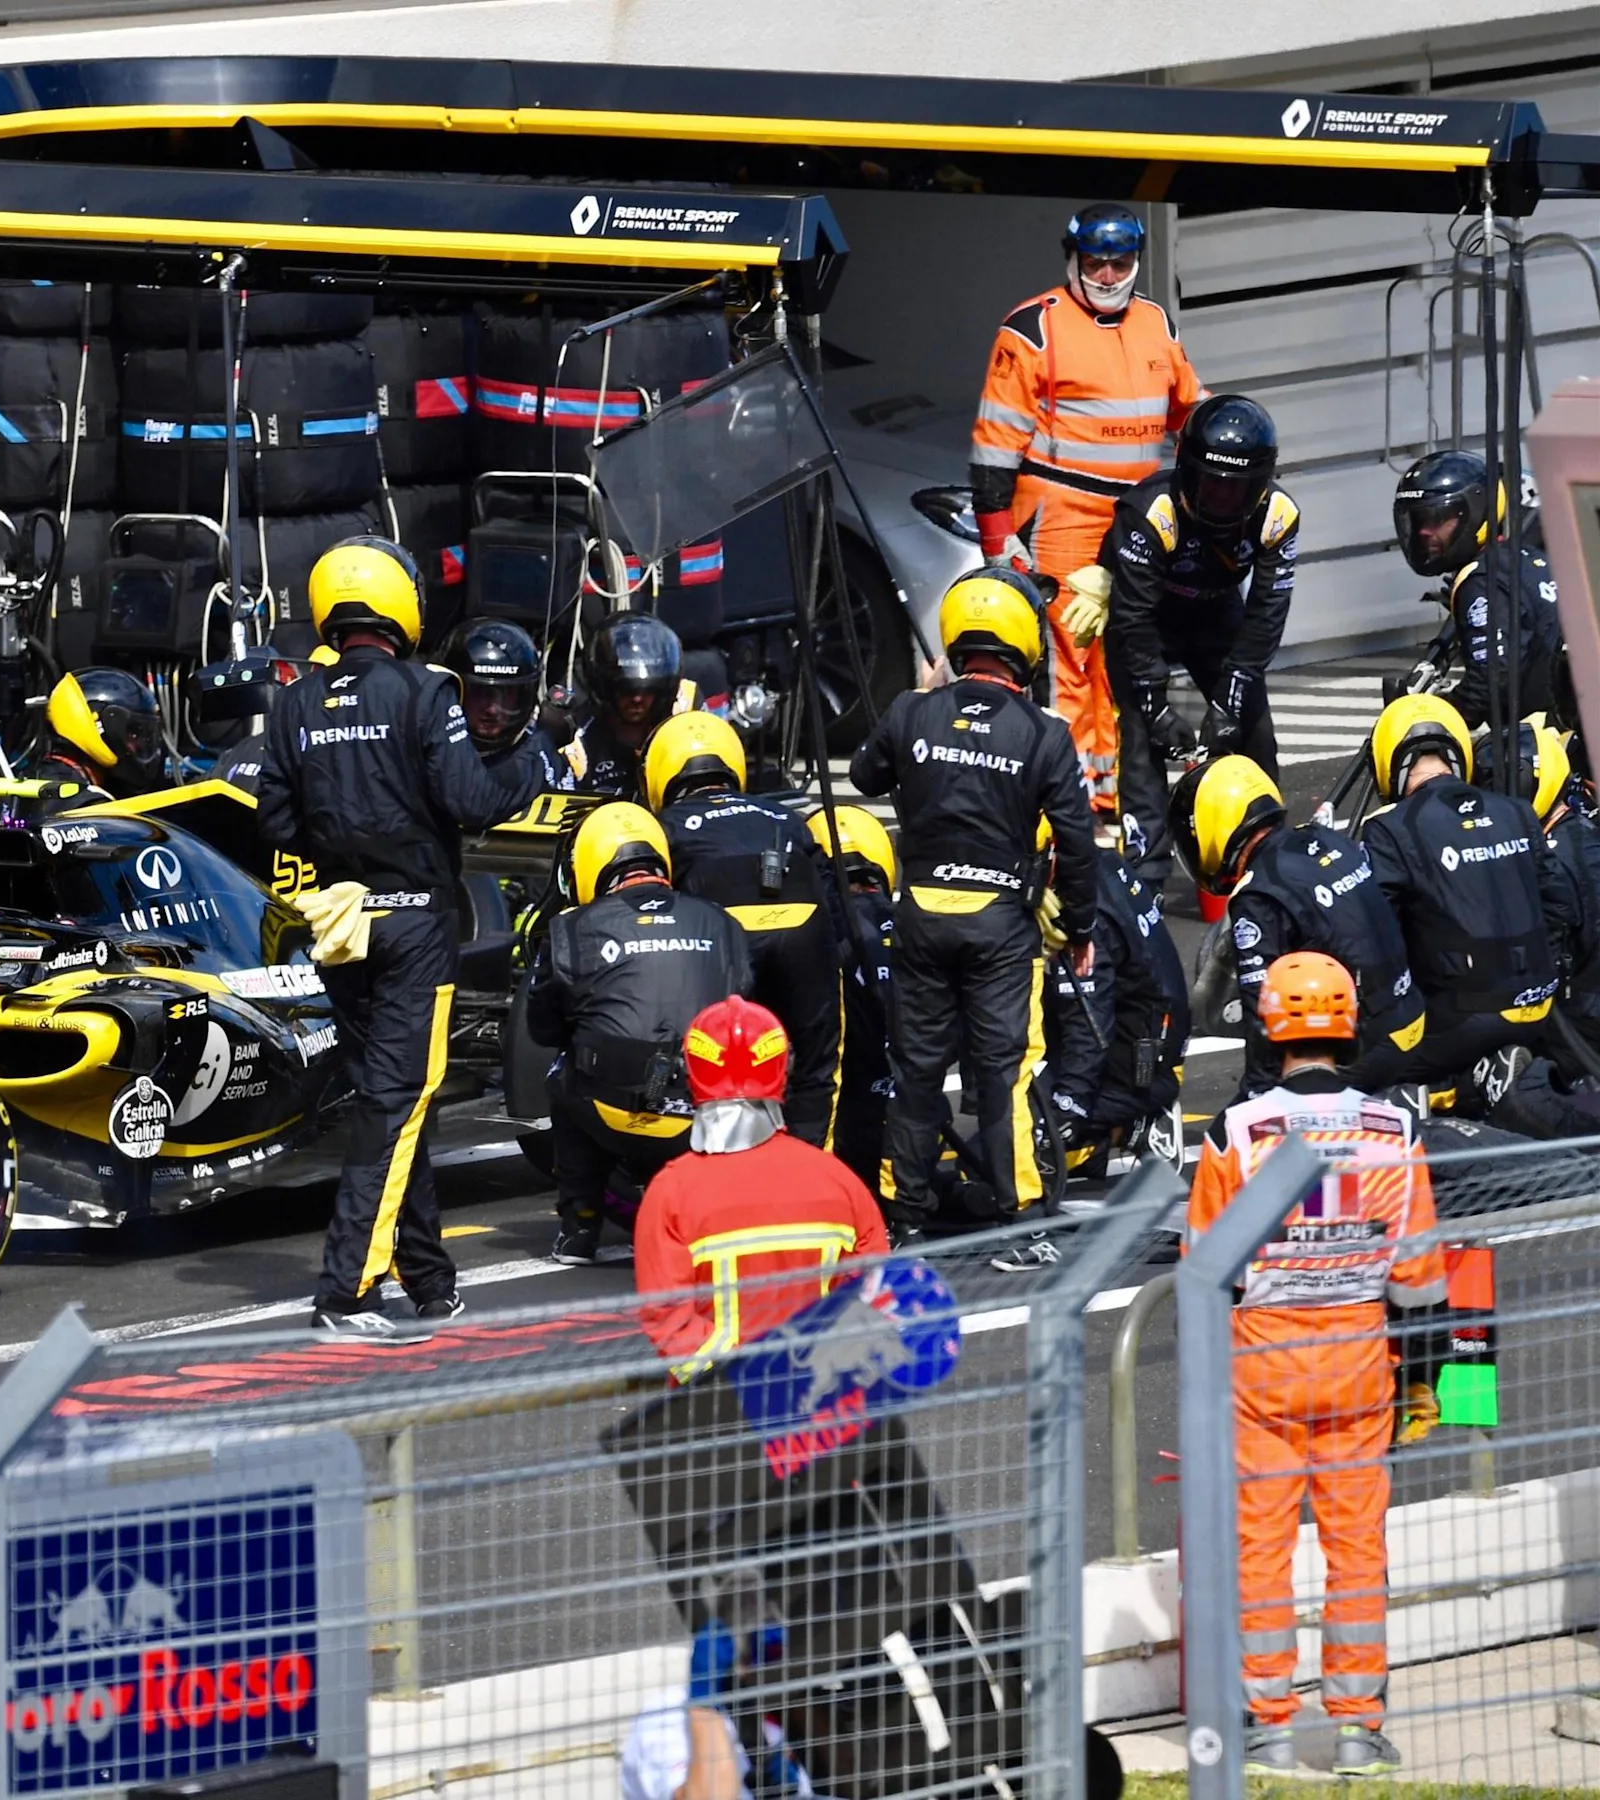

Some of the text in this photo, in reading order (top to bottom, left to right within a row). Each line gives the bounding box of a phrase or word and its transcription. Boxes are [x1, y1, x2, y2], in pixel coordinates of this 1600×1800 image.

[1326, 110, 1448, 126] RENAULT SPORT
[1323, 122, 1433, 135] FORMULA ONE TEAM
[615, 206, 740, 223] RENAULT SPORT
[612, 220, 725, 233] FORMULA ONE TEAM
[144, 419, 177, 433] Rear
[1151, 424, 1167, 436] TEA
[143, 430, 171, 444] Left
[1205, 452, 1250, 467] RENAULT
[474, 664, 519, 675] RENAULT
[310, 725, 390, 746] RENAULT
[932, 745, 1025, 776] RENAULT
[61, 826, 99, 844] LaLiga
[1462, 837, 1530, 865] RENAULT
[120, 898, 220, 933] INFINITI
[7, 948, 39, 960] Castrol
[624, 939, 714, 956] RENAULT
[268, 964, 326, 998] EDGE
[14, 1017, 34, 1029] Bell
[57, 1018, 87, 1031] Ross
[234, 1043, 261, 1062] BANK
[192, 1053, 222, 1091] ci
[229, 1064, 253, 1081] AND
[222, 1080, 268, 1101] SERVICES
[121, 1101, 167, 1123] Estrella
[124, 1120, 166, 1143] Galicia
[1287, 1226, 1320, 1241] PIT
[1451, 1338, 1488, 1352] Team
[8, 1647, 312, 1753] oro Rosso
